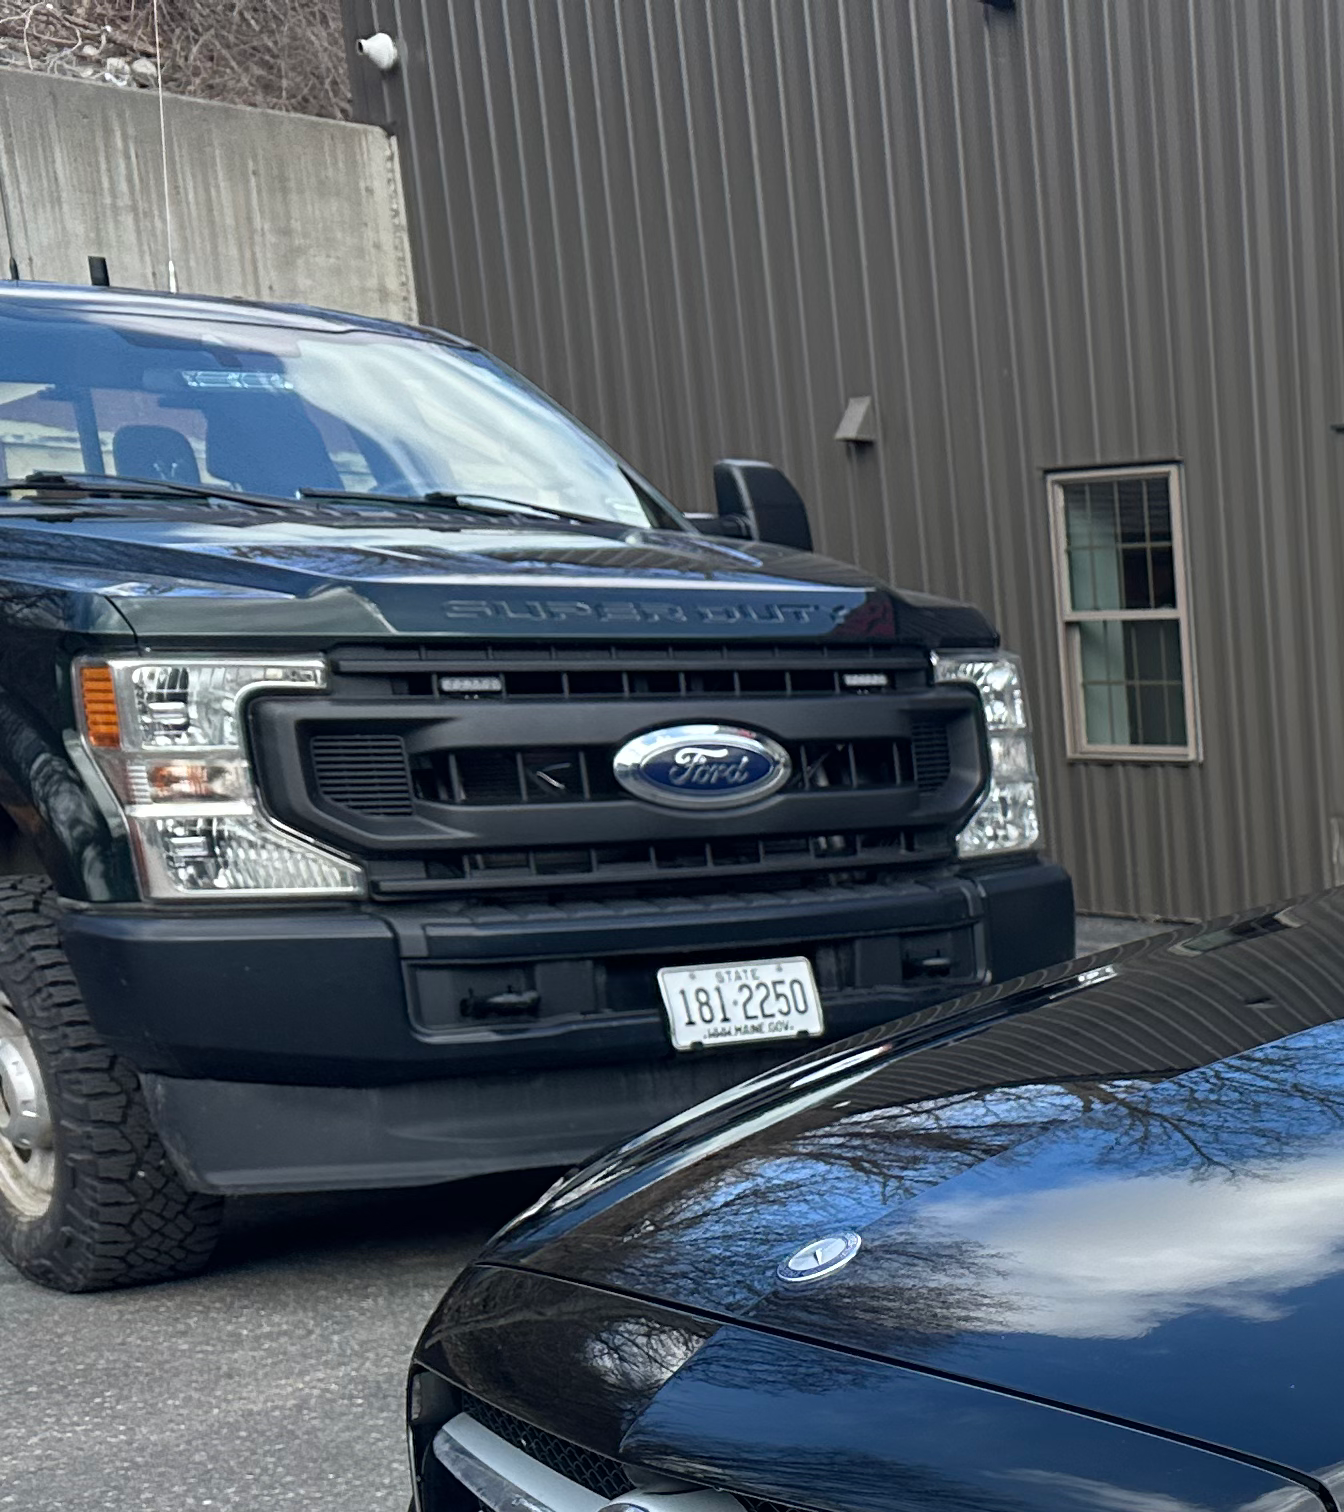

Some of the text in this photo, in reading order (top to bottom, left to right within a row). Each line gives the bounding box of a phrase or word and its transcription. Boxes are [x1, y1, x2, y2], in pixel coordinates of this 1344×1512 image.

[443, 600, 688, 622] SUPER
[669, 746, 750, 786] Ford
[714, 968, 761, 984] STATE
